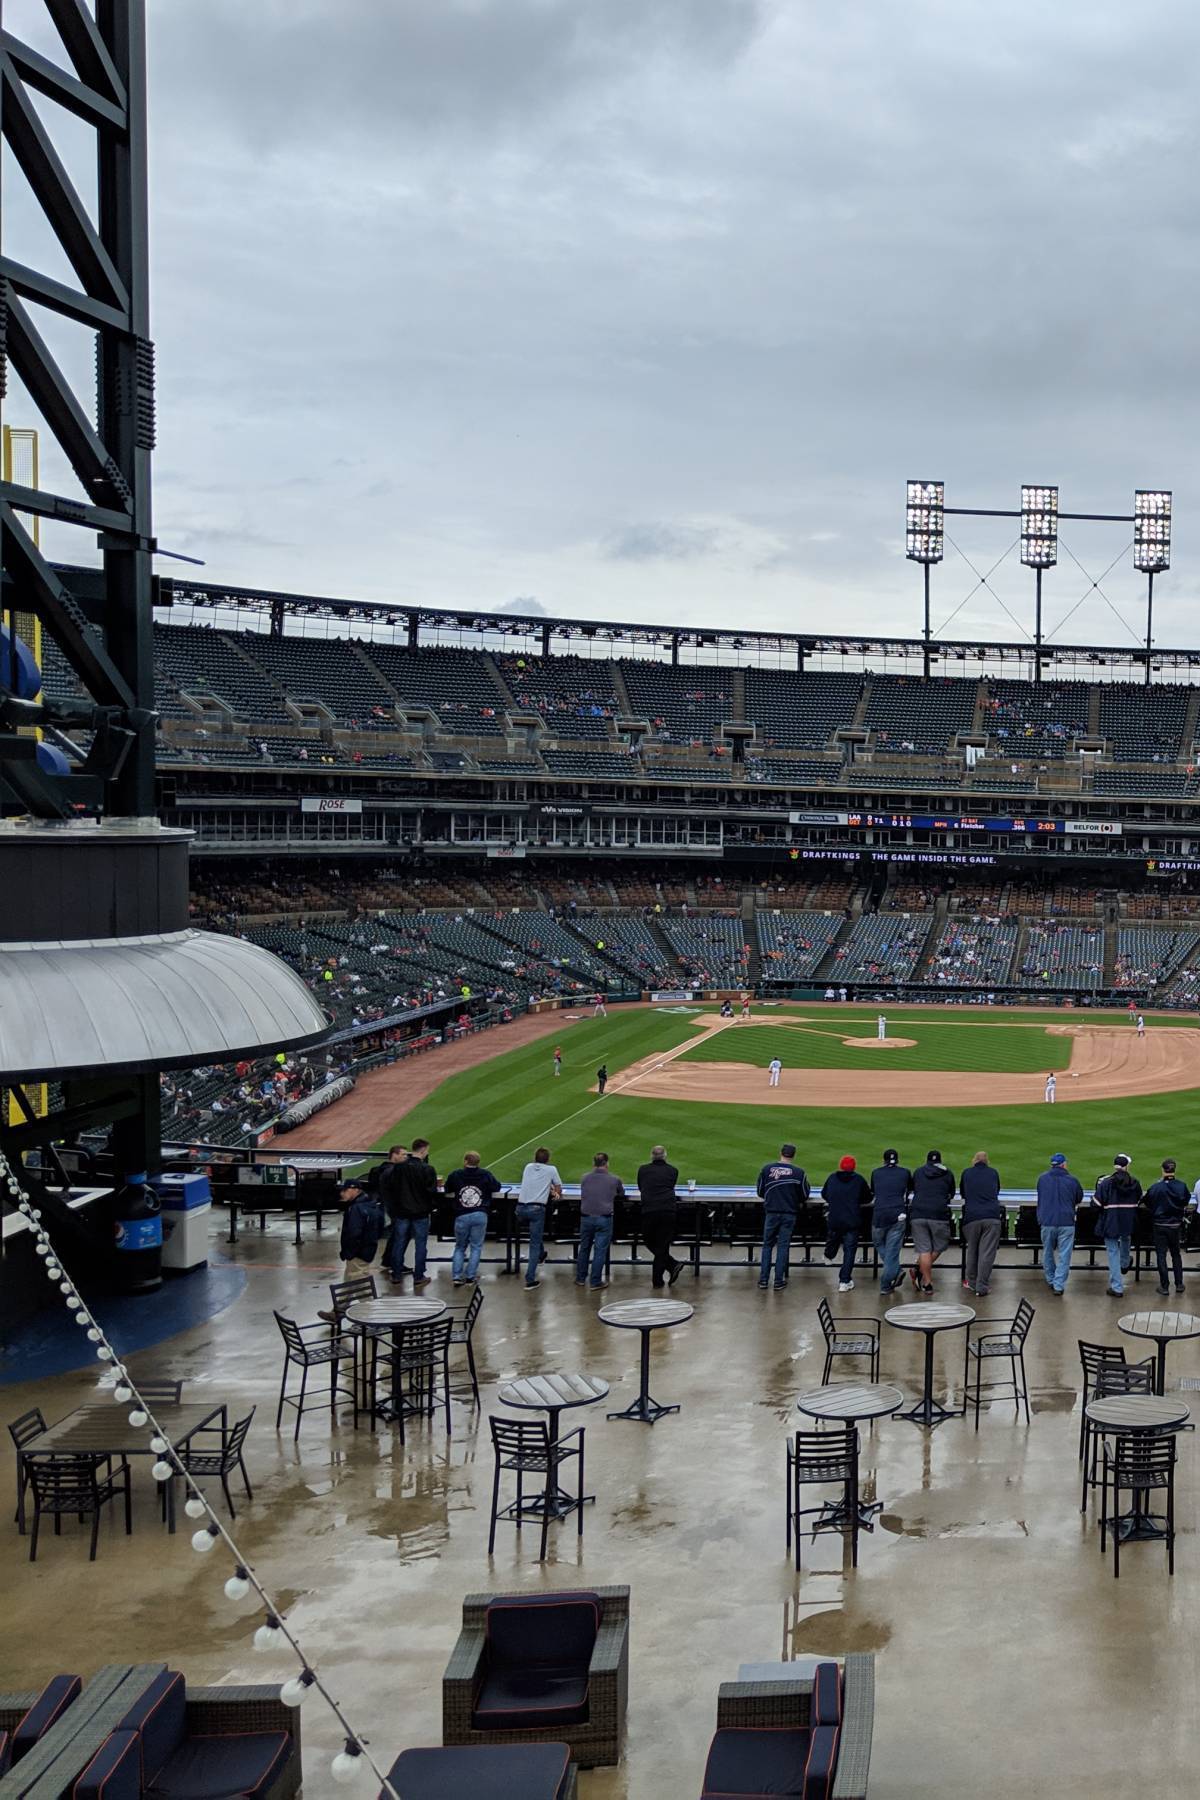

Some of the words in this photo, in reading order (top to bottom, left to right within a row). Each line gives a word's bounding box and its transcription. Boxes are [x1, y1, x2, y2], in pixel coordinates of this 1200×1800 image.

[319, 799, 345, 811] ROSE
[1037, 822, 1056, 830] 2:03
[802, 851, 861, 860] DRAFTKINGS
[891, 853, 916, 861] GAME
[918, 854, 948, 863] INSIDE
[950, 855, 967, 863] THE
[274, 1175, 280, 1183] 2
